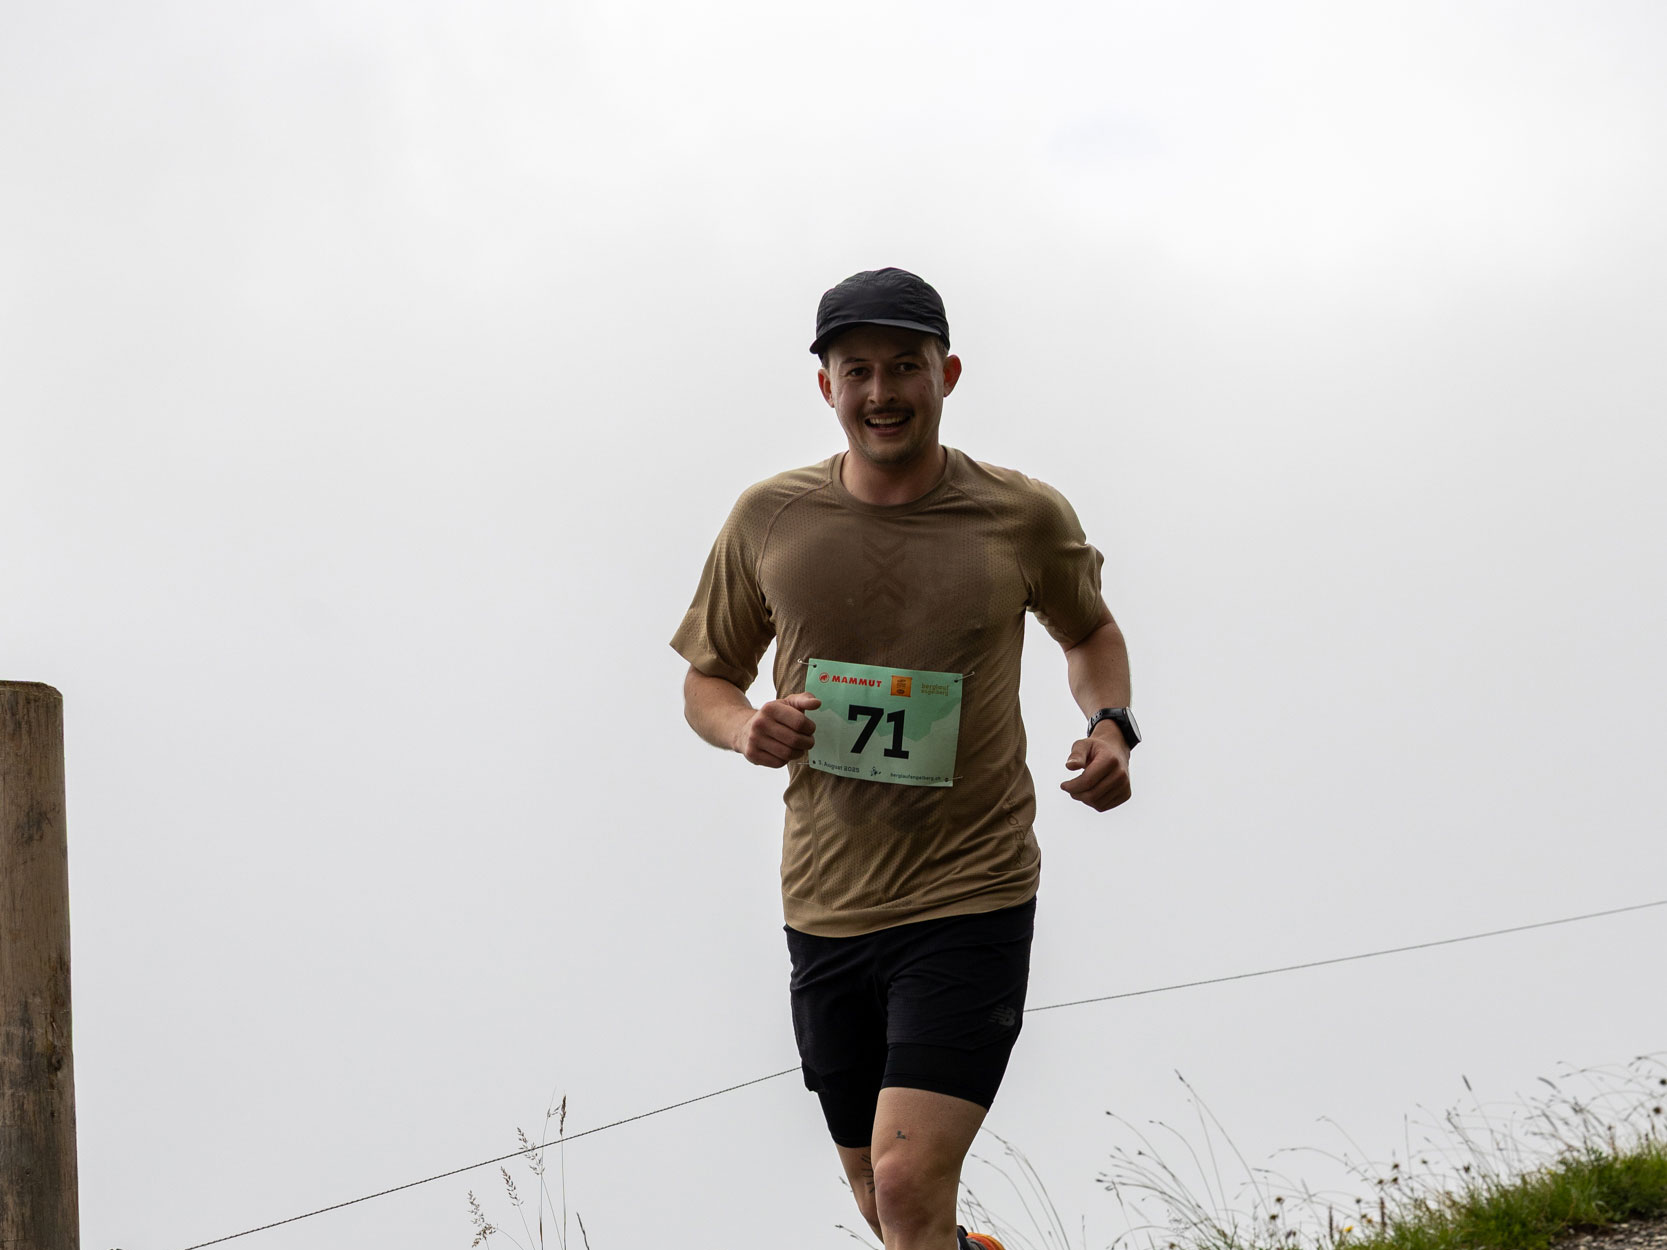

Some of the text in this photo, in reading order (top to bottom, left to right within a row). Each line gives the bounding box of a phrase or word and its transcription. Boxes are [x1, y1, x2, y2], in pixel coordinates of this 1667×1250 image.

[832, 675, 882, 688] MAMMUT
[847, 704, 910, 760] 71
[824, 761, 843, 771] August
